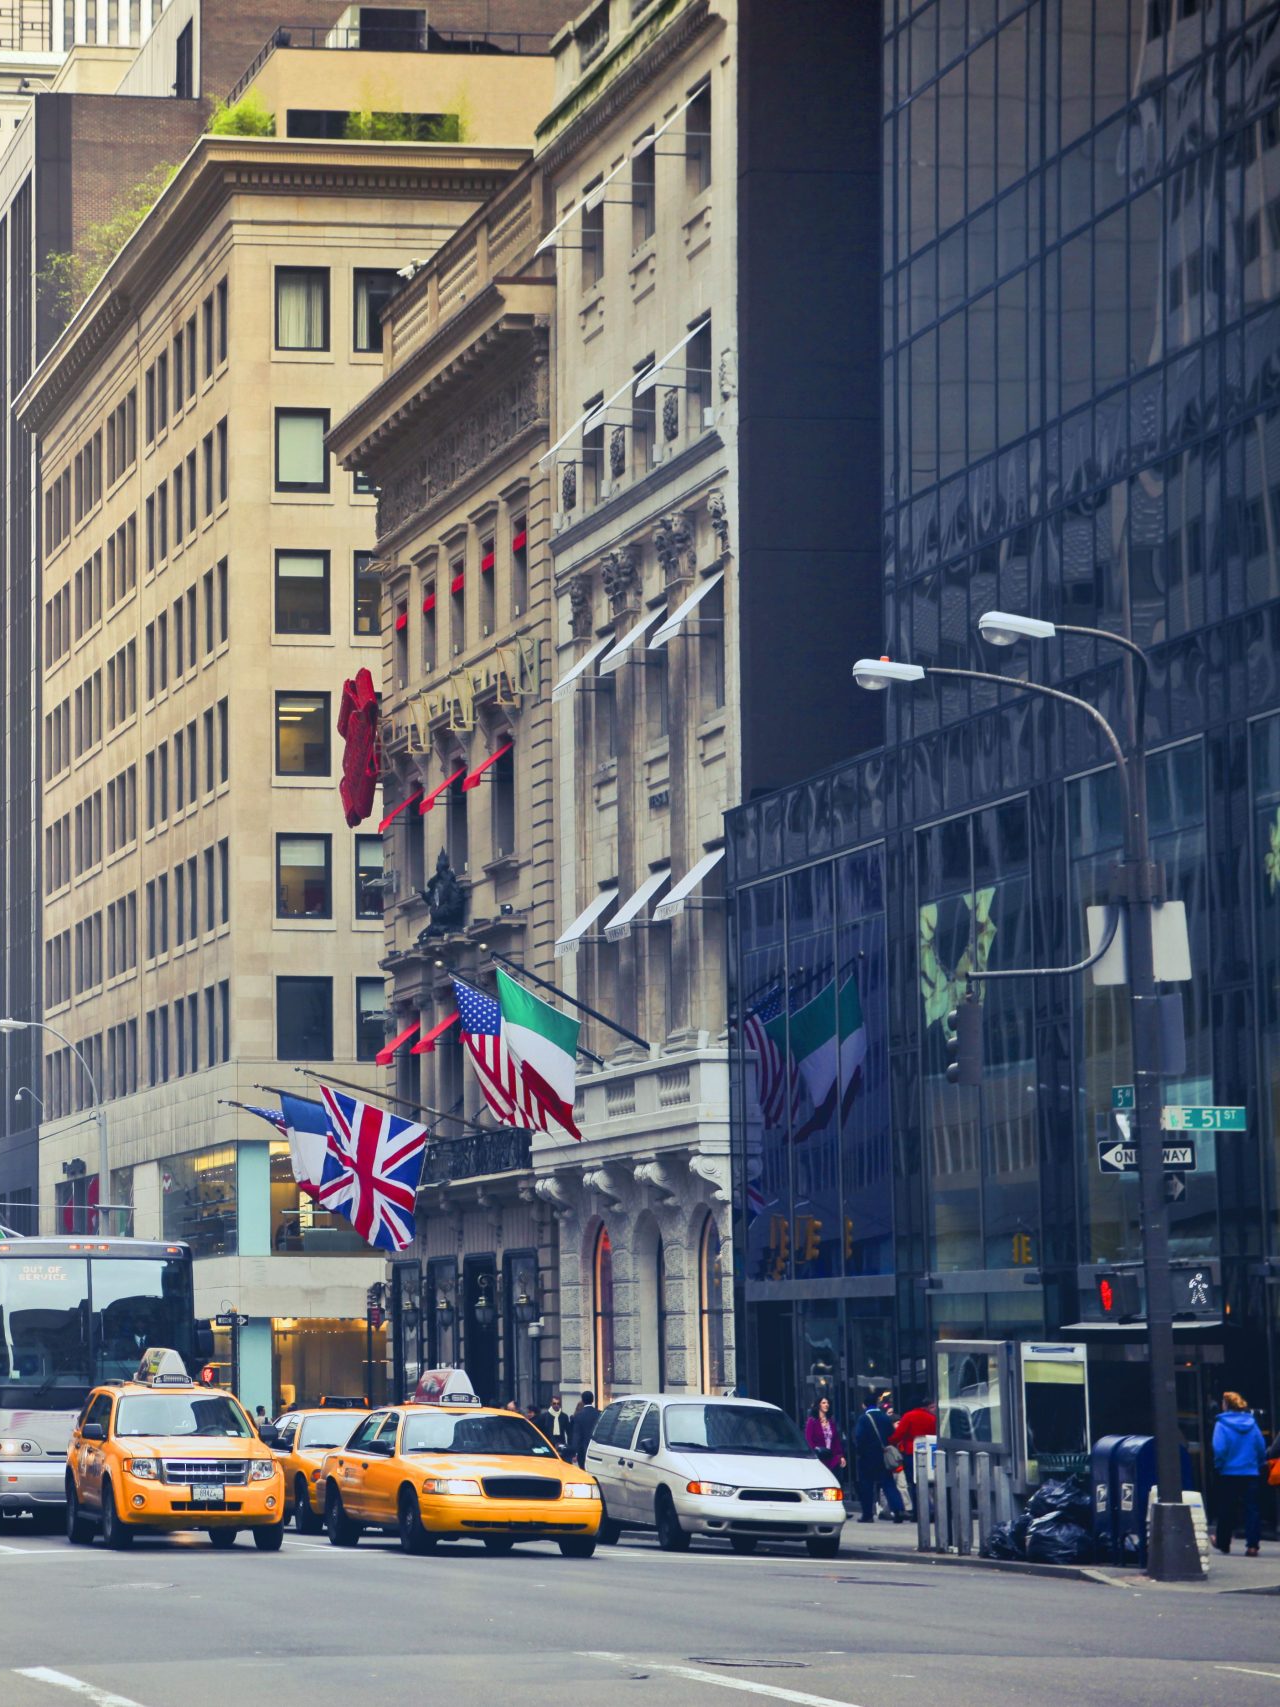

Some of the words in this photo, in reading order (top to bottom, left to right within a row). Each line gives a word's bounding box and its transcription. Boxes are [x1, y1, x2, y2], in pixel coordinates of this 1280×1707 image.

[1117, 1089, 1124, 1107] 5
[1183, 1110, 1193, 1127] E
[1201, 1109, 1221, 1128] 51
[1224, 1110, 1237, 1119] ST
[1162, 1150, 1188, 1162] WAY
[23, 1265, 43, 1274] OUT
[47, 1265, 63, 1274] OF
[18, 1273, 68, 1281] SERVICE
